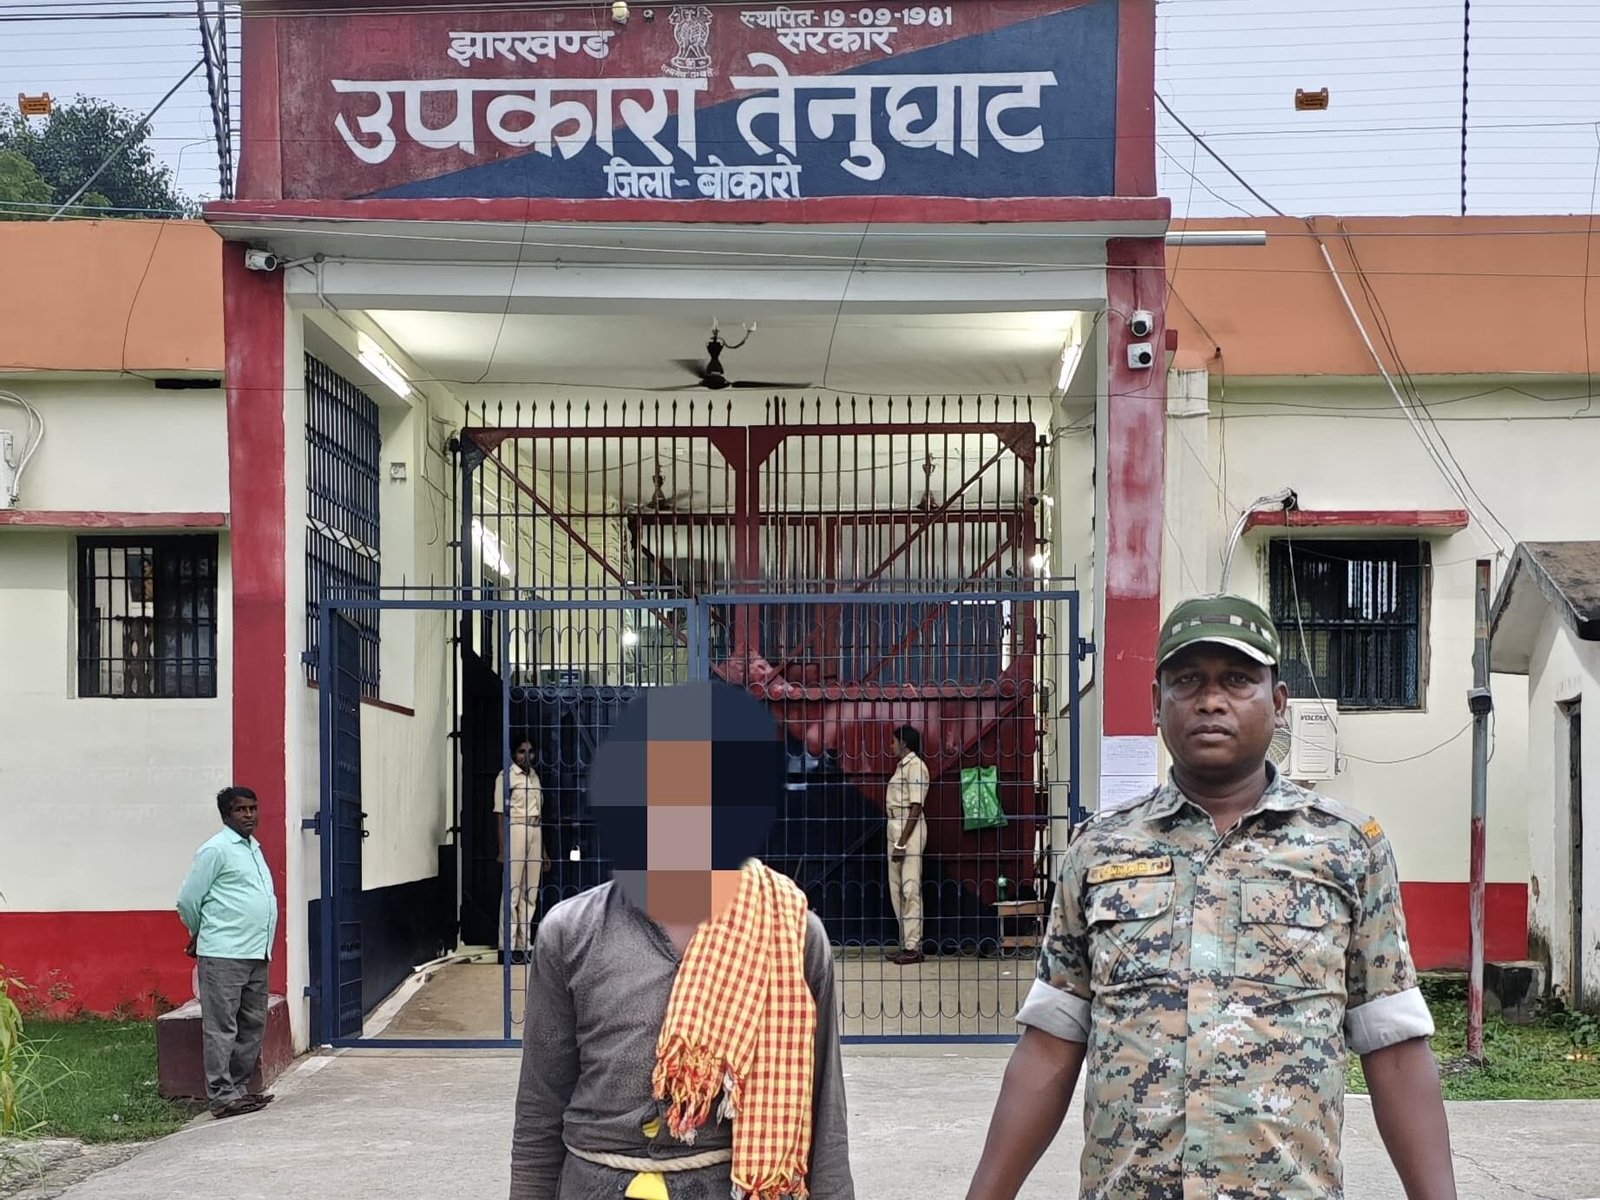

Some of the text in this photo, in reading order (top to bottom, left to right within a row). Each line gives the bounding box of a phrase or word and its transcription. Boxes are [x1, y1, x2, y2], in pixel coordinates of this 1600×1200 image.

[448, 27, 898, 67] झारखण्ड सरकार
[331, 53, 1057, 180] उपकारा तेनुघाट
[694, 154, 801, 199] बोकारो
